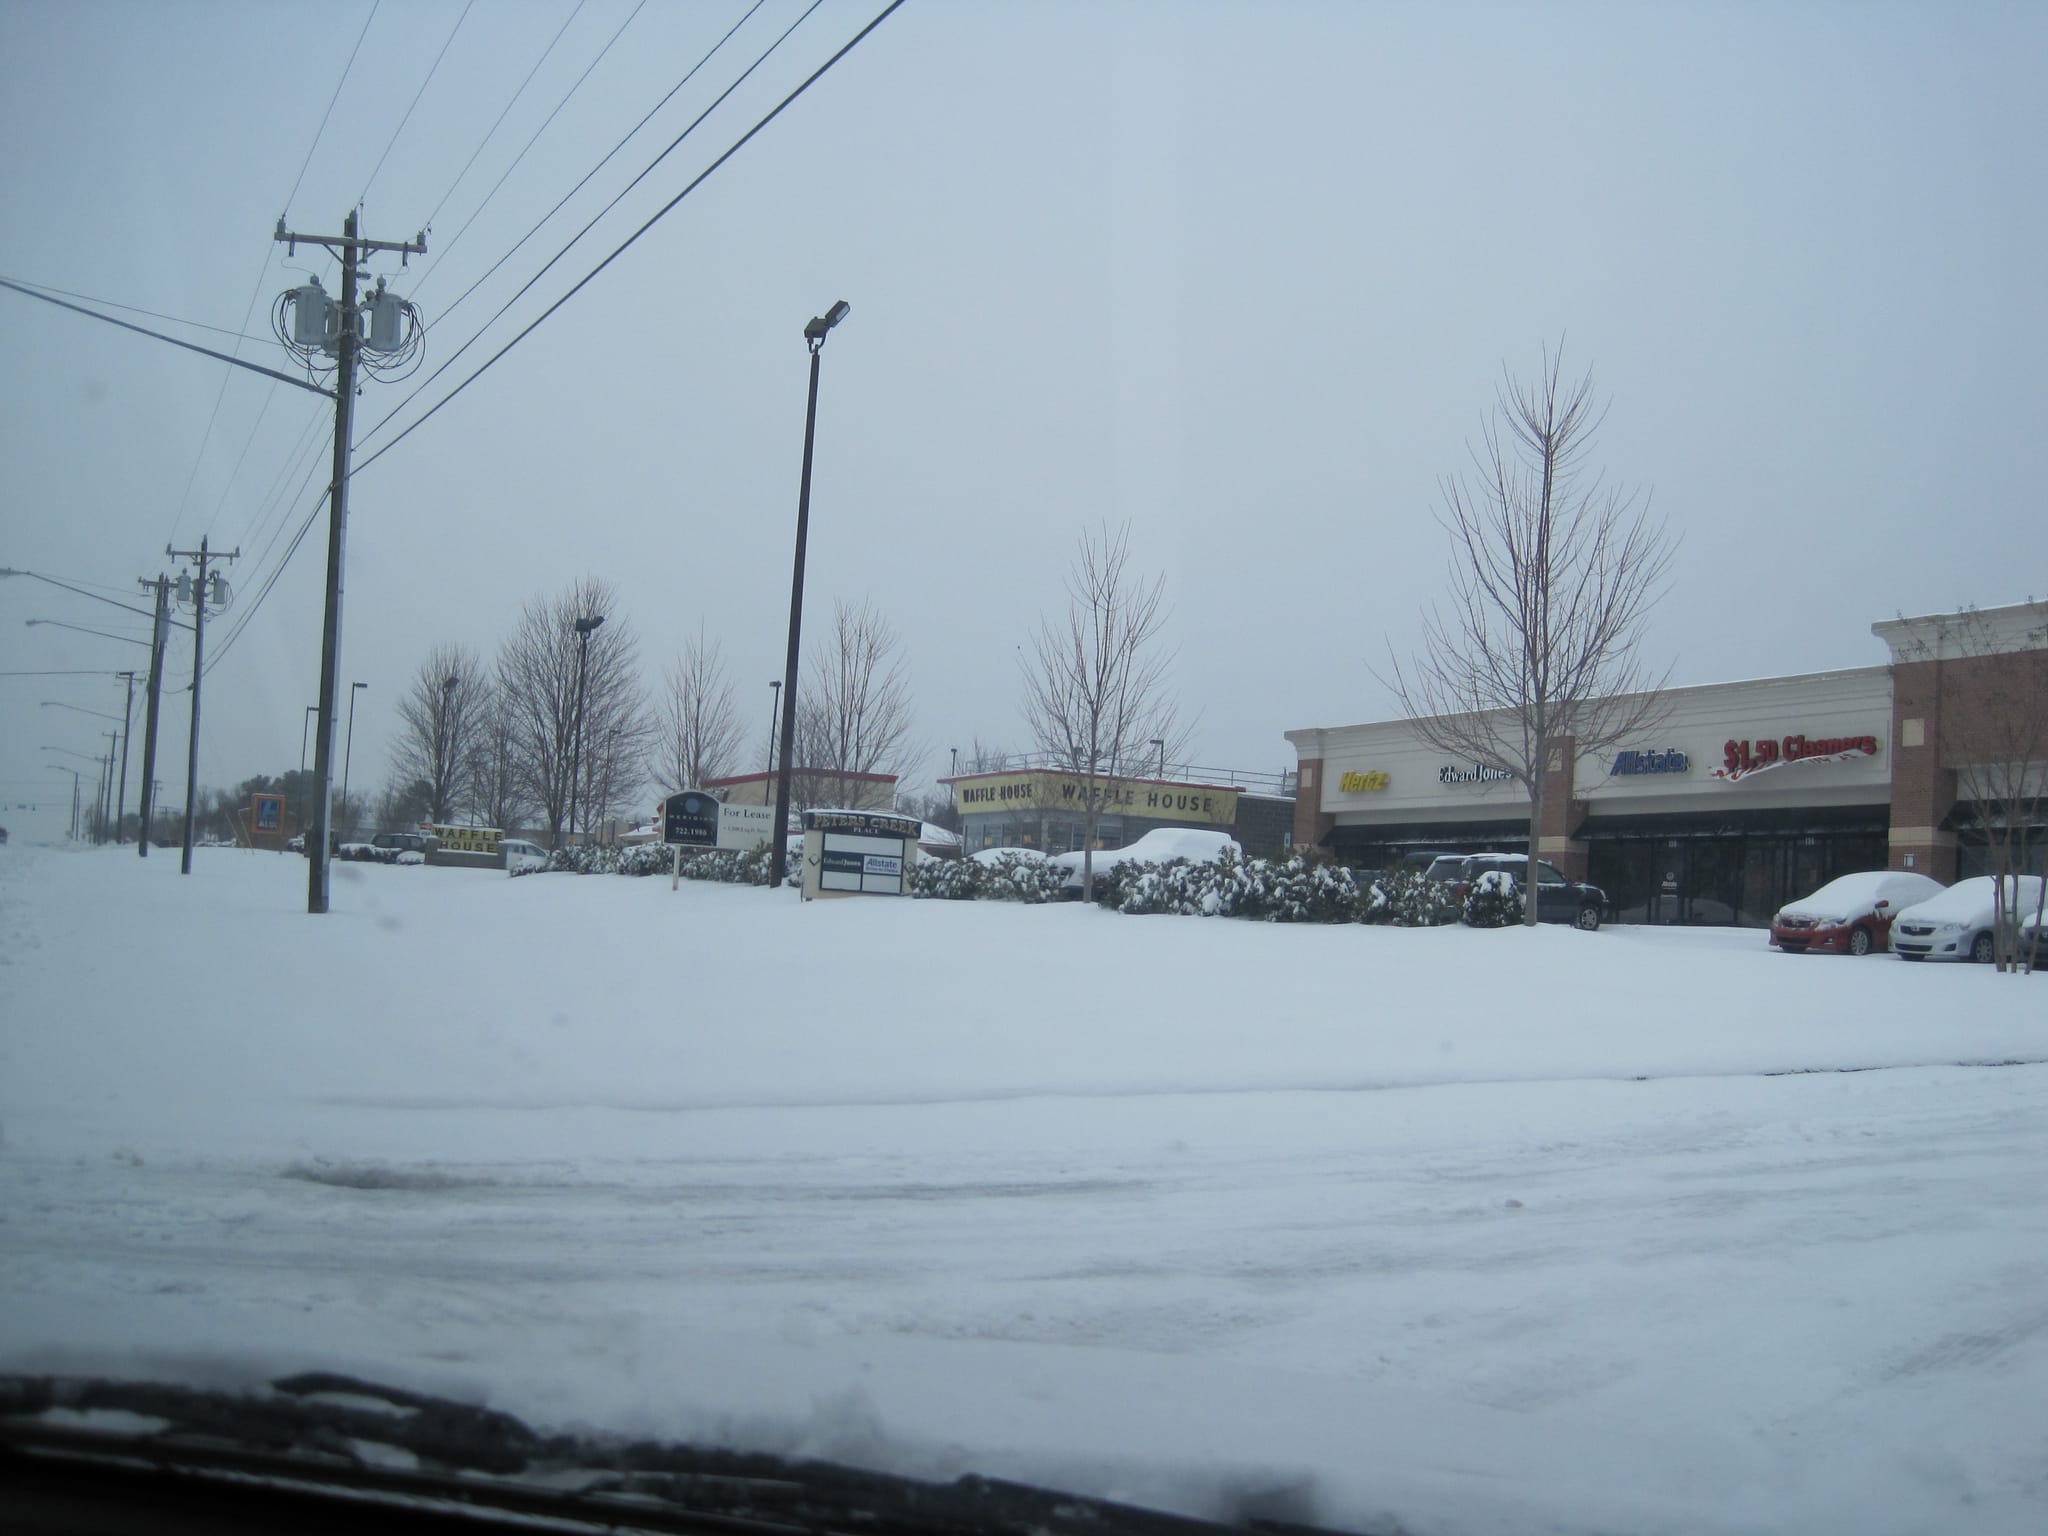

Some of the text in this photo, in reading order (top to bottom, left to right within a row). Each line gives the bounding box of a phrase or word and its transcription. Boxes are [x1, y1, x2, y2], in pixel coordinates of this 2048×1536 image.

[1782, 734, 1877, 763] Cleaners
[1610, 747, 1688, 776] Allstate
[1339, 771, 1388, 793] Hertz
[1438, 764, 1513, 783] Edward Jones
[963, 783, 1032, 803] WAFFLE HOUSE
[1062, 784, 1213, 813] WAFFLE HOUSE
[724, 807, 771, 819] For Lease
[434, 827, 503, 841] WAFFLE
[813, 814, 917, 835] PETERS CREEK
[440, 841, 497, 853] HOUSE
[866, 858, 898, 868] Allstate
